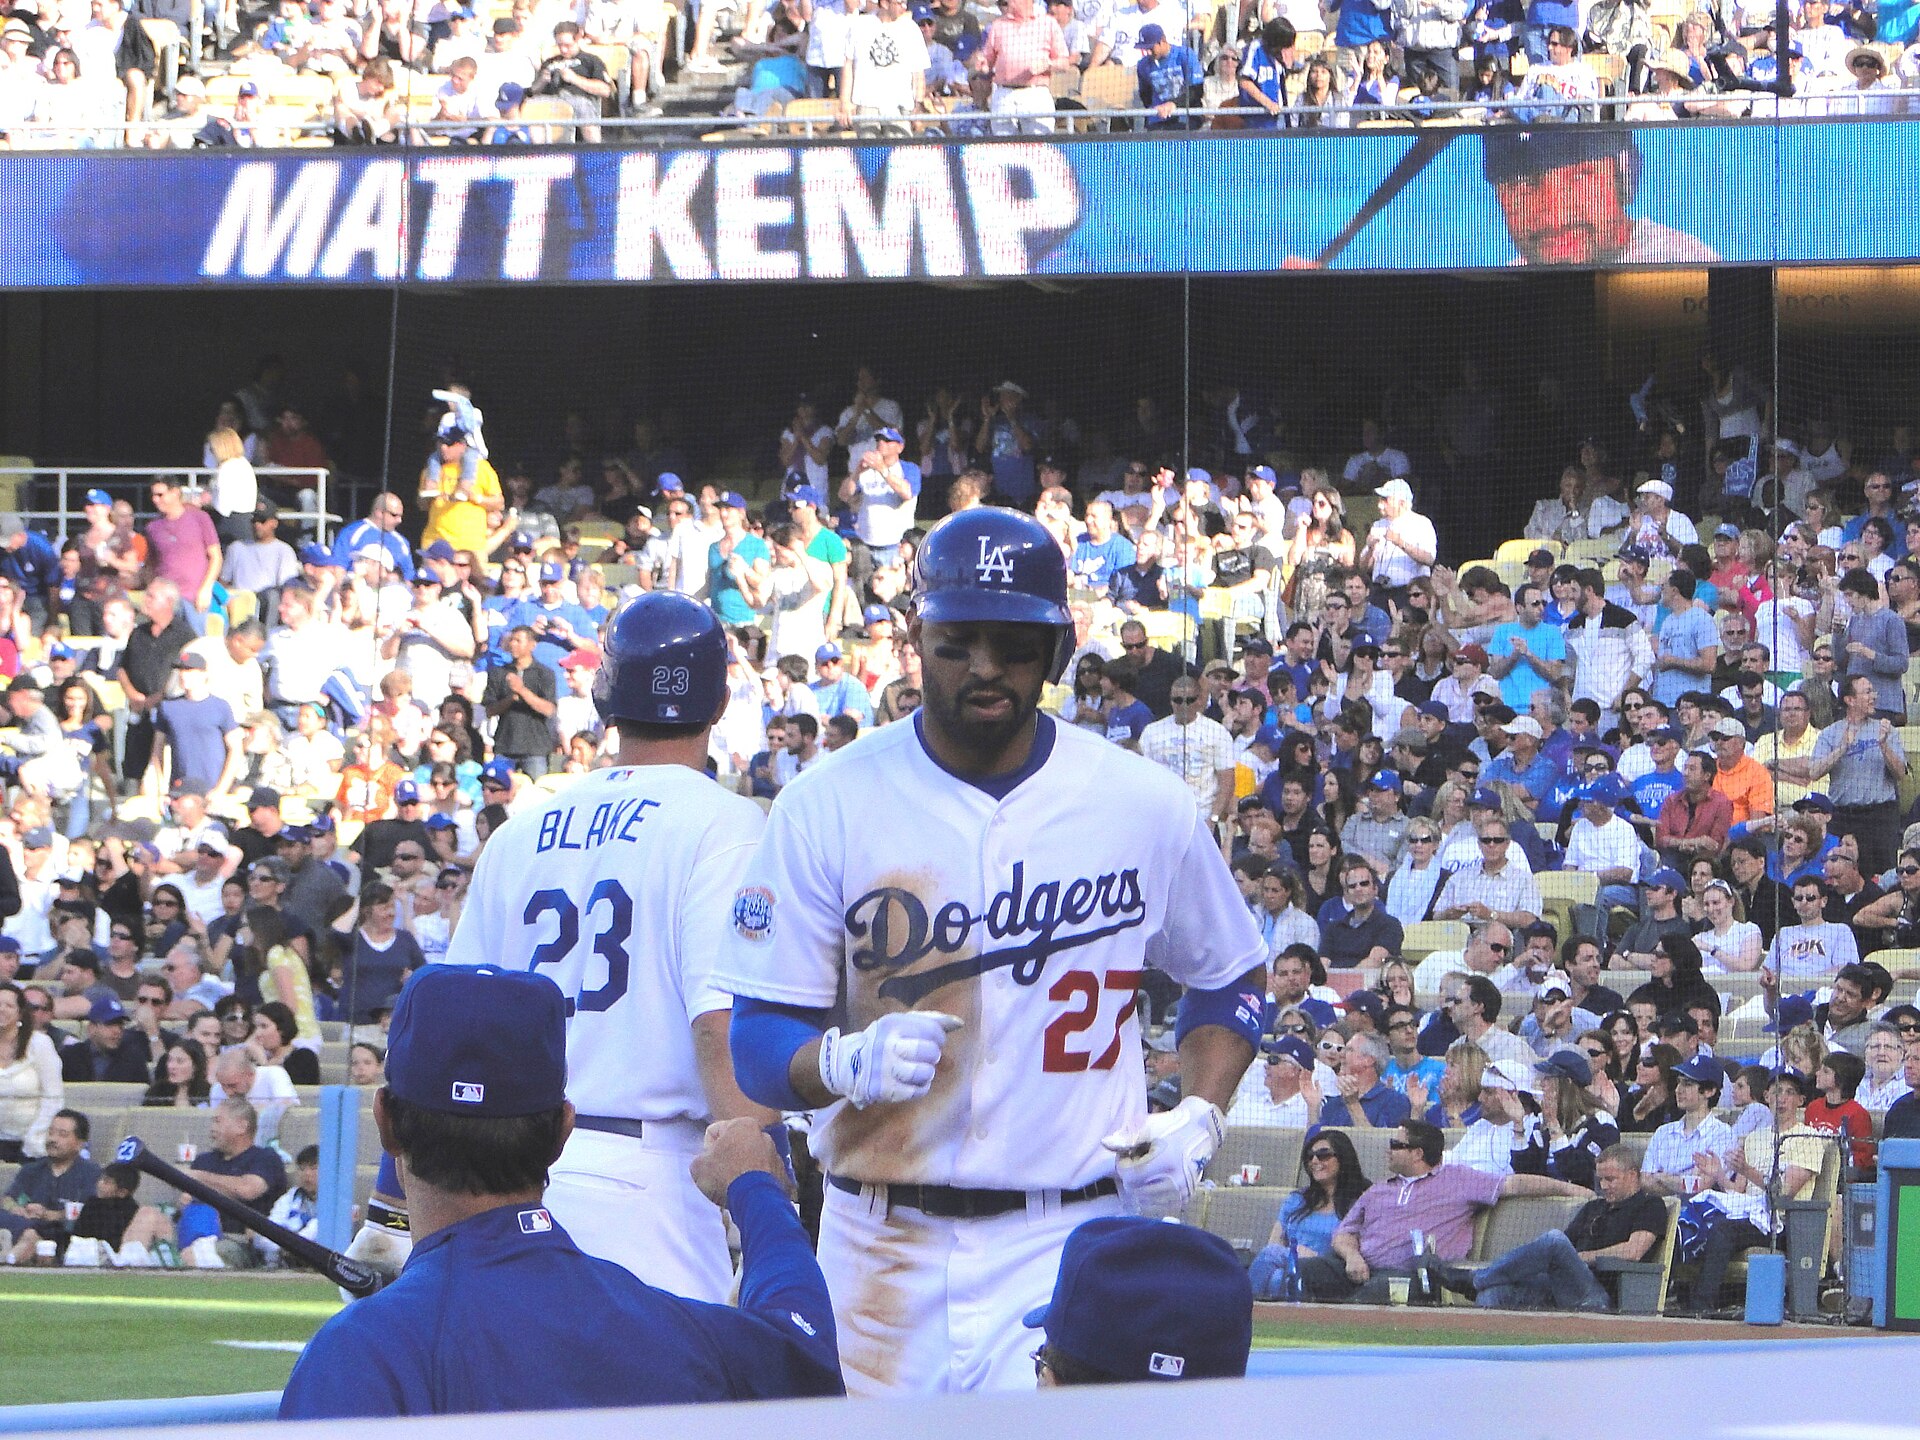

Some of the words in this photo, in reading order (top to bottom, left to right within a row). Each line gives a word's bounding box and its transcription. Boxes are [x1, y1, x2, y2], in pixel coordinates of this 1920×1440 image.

[198, 154, 576, 280] MATT
[613, 142, 1079, 280] KEMP
[975, 535, 1014, 583] LA
[652, 665, 689, 695] 23
[536, 798, 661, 853] BLAKE
[523, 879, 633, 1018] 23
[845, 859, 1146, 1006] Dodgers
[1042, 970, 1144, 1073] 27
[117, 1140, 137, 1161] 23
